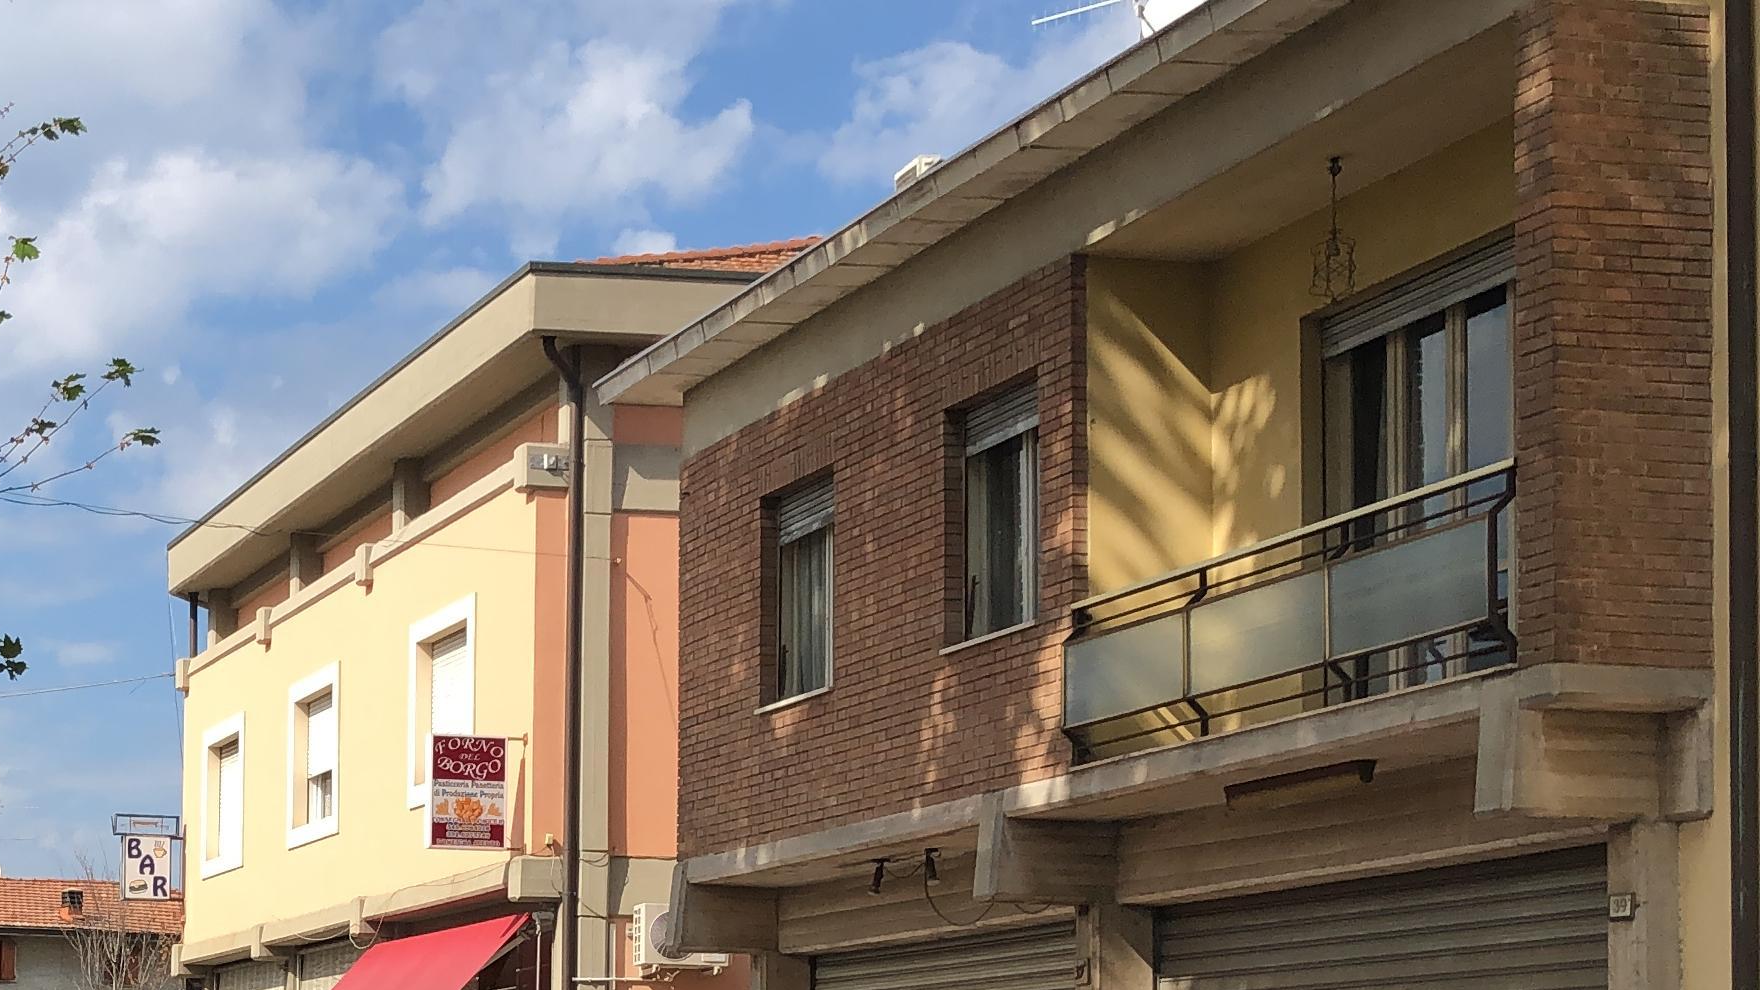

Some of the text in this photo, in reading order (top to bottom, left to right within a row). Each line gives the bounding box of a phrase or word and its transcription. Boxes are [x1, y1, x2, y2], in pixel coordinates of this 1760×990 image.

[434, 737, 504, 758] FORNO
[437, 756, 502, 780] BORGO
[127, 838, 168, 897] BAR
